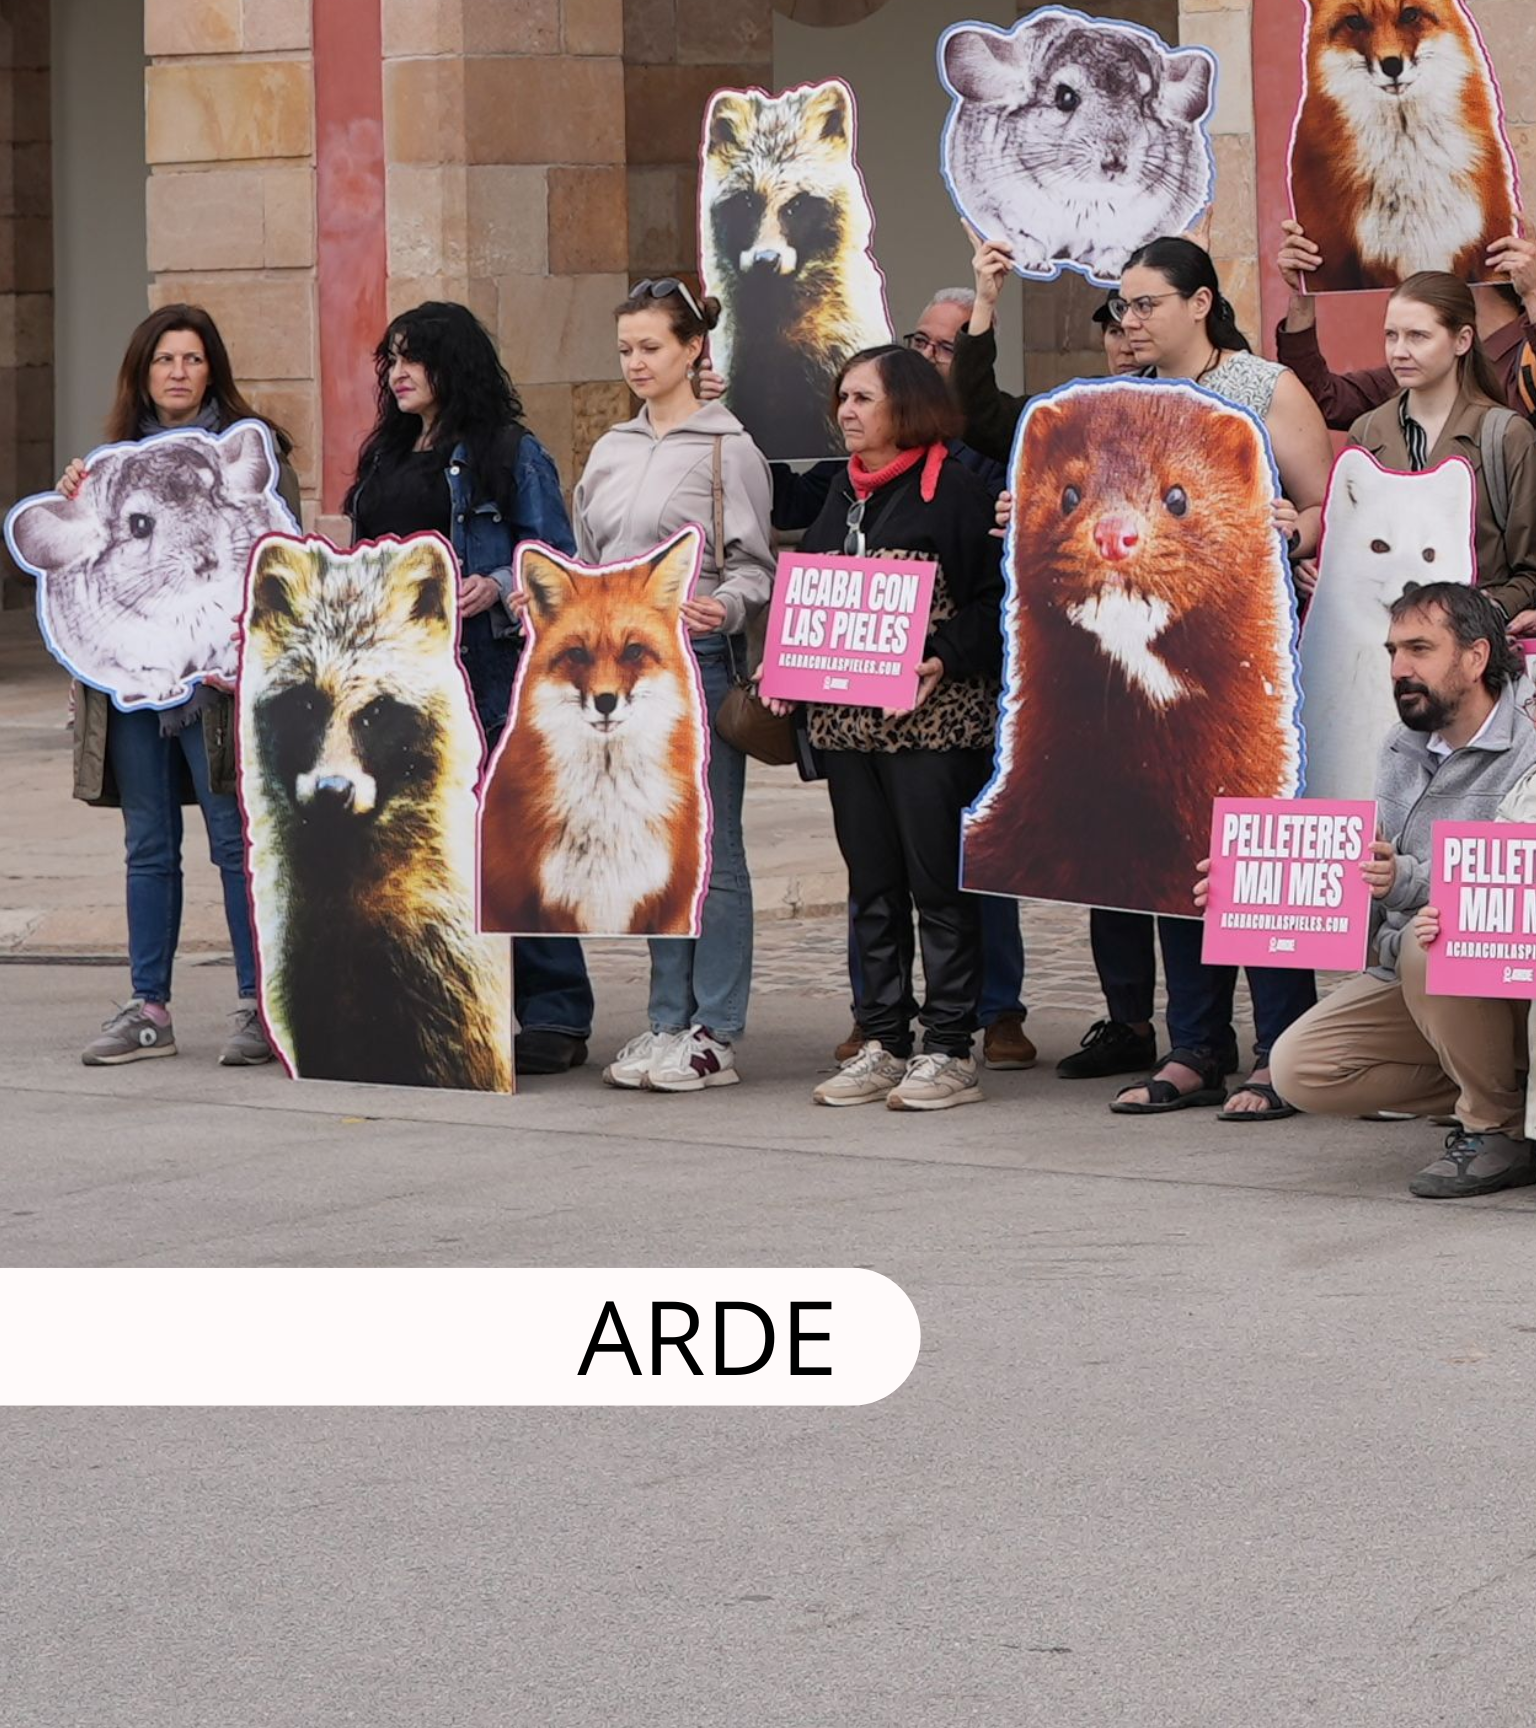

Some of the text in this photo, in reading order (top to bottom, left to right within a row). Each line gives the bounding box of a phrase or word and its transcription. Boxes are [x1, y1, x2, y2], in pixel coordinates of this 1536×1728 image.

[785, 567, 919, 613] ACABA CON
[781, 608, 910, 654] LAS PIELES
[1222, 814, 1363, 860] PELLETERES
[1233, 860, 1344, 907] MAI MÉS
[1459, 887, 1515, 933] MAI
